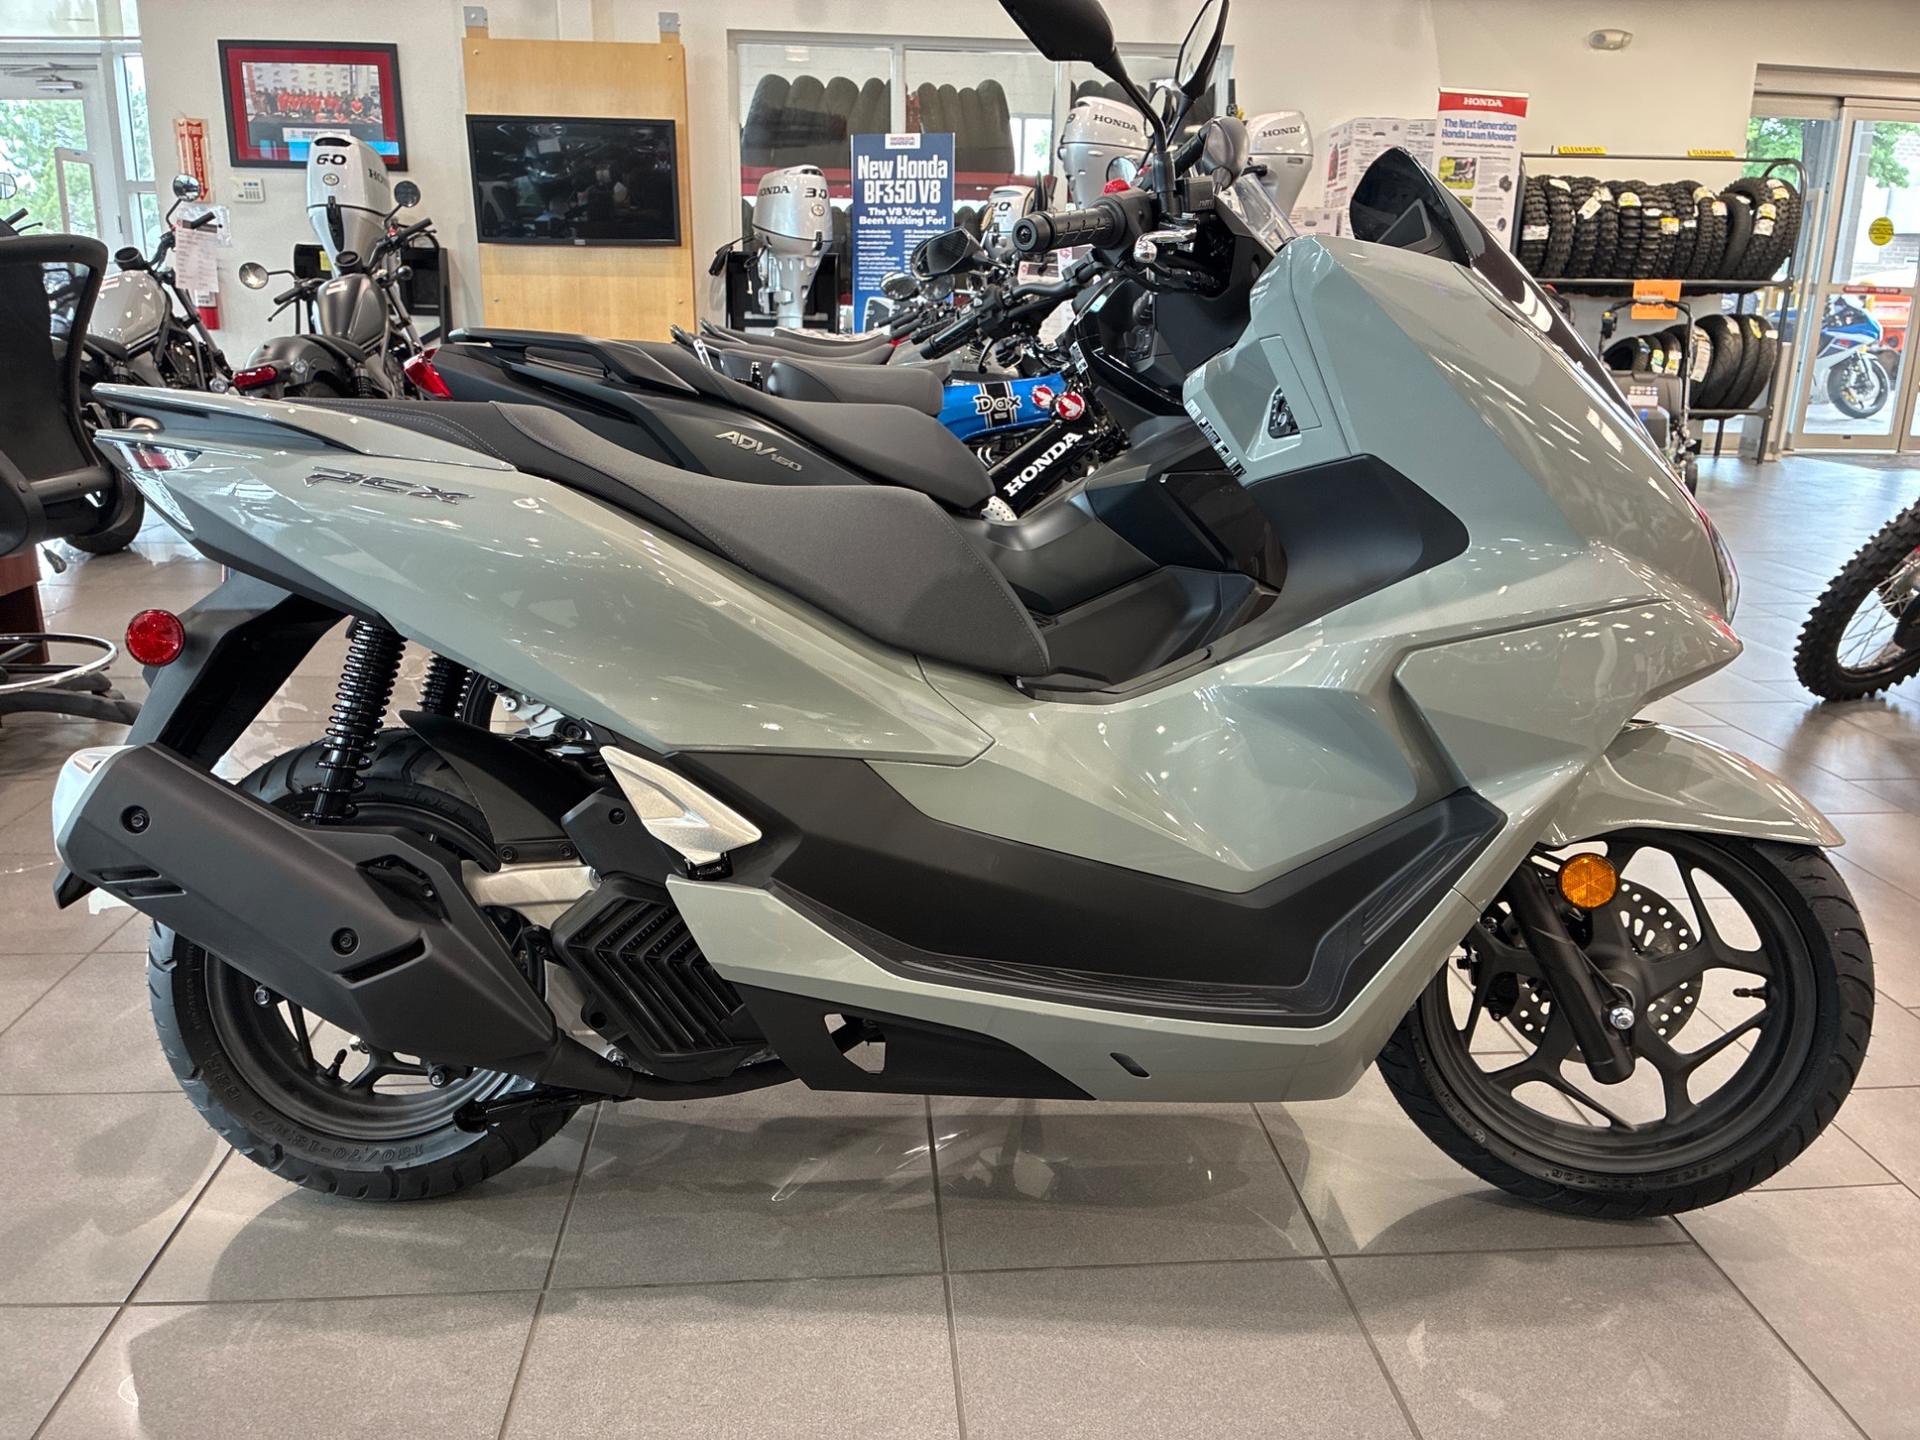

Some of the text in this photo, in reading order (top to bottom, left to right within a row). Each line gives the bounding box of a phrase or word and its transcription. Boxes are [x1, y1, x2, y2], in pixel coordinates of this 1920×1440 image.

[1463, 97, 1503, 108] HONDA
[1093, 114, 1138, 132] HONDA
[1444, 118, 1517, 131] The Next Generation
[1441, 129, 1516, 142] Honda Lawn Mowers
[316, 154, 347, 165] 60
[858, 154, 949, 179] New Honda
[804, 187, 827, 199] 30
[863, 180, 941, 204] BF350 V8
[868, 207, 937, 216] The V8 You've
[859, 216, 946, 227] Been Waiting For!
[974, 395, 1022, 414] Dax
[1003, 432, 1083, 497] HONDA
[303, 466, 476, 505] PCX
